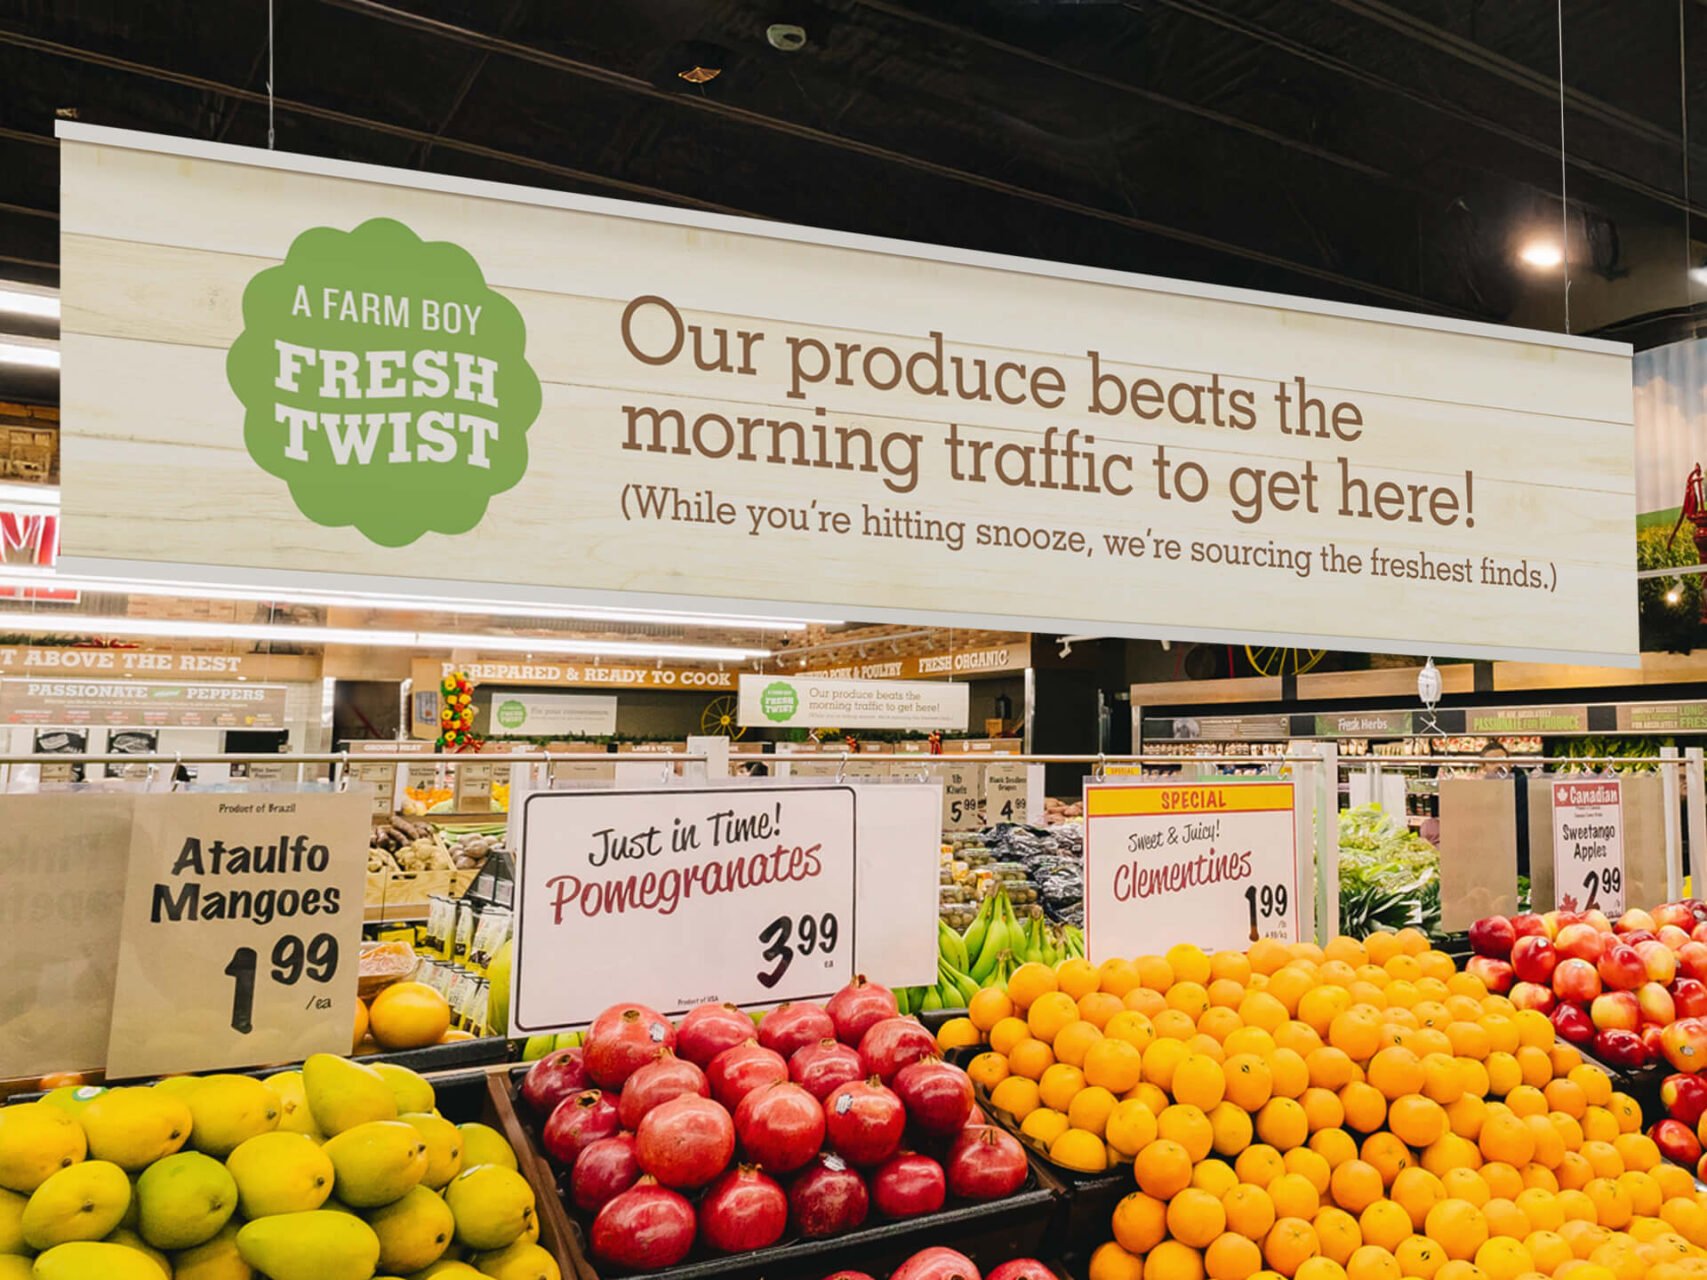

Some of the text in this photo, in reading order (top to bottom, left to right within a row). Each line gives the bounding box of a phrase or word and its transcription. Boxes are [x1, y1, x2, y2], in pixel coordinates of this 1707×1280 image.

[292, 285, 482, 335] A FARM BOY
[274, 339, 498, 408] FRESH
[621, 295, 1363, 442] Our produce beats the
[274, 402, 498, 469] TWIST
[621, 405, 1475, 528] morning traffic to get here!
[621, 484, 737, 525] (While
[862, 504, 966, 551] hitting
[976, 522, 1093, 558] snooze,
[1190, 540, 1312, 577] sourcing
[1319, 544, 1363, 575] the
[1370, 548, 1473, 584] freshest
[1480, 558, 1558, 592] finds.)
[24, 649, 115, 668] ABOVE
[122, 653, 172, 671] THE
[179, 655, 242, 672] REST
[861, 662, 903, 679] POULTRY
[919, 649, 1009, 673] FRESH ORGANIC
[566, 667, 579, 681] &
[584, 668, 647, 683] READY
[651, 670, 676, 684] TO
[680, 671, 731, 686] COOK
[27, 684, 148, 698] PASSIONATE
[186, 687, 265, 701] PEPPERS
[809, 687, 922, 703] Our produce beats the
[809, 700, 851, 713] morning
[886, 701, 896, 711] to
[898, 703, 914, 713] get
[1361, 717, 1388, 730] Herbs
[1161, 790, 1227, 810] SPECIAL
[1569, 785, 1617, 804] Canadian
[218, 803, 296, 813] Product of Brazil
[588, 802, 782, 867] Just in Time!
[1128, 819, 1221, 853] Sweet & Juicy!
[1562, 824, 1615, 841] Sweetango
[171, 835, 329, 876] Ataulfo
[1574, 841, 1607, 861] Apples
[545, 843, 822, 925] Pomegranates
[1113, 847, 1252, 902] Clementines
[150, 882, 340, 926] Mangoes
[305, 995, 331, 1010] /ea
